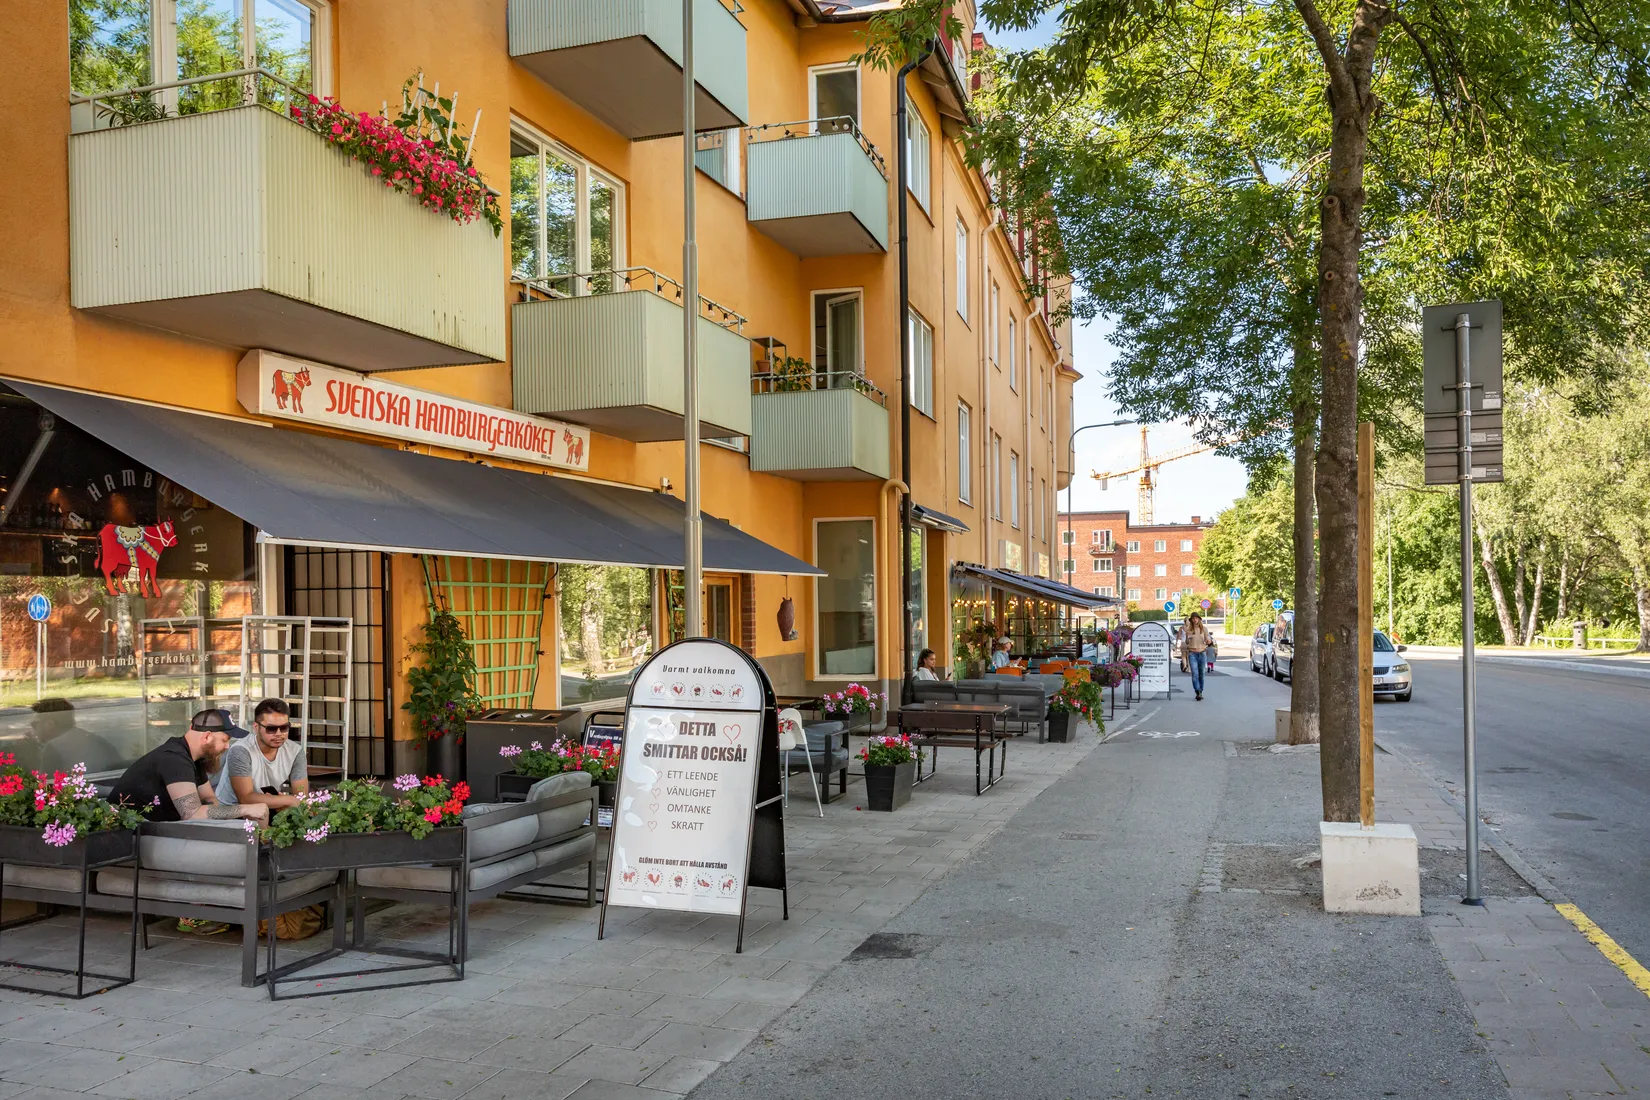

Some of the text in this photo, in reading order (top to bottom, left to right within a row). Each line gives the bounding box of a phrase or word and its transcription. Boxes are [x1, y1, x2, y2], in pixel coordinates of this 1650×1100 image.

[325, 379, 556, 455] SVENSKA HAMBURGERKÖKET
[61, 511, 114, 634] SVENSKA
[662, 664, 690, 674] Varmt
[679, 721, 717, 737] DETTA
[643, 743, 748, 762] SMITTAR OCKSÅ!
[667, 770, 719, 781] ETT LEENDE
[666, 785, 717, 798] VÄNLIGHET
[667, 803, 712, 815] OMTANKE
[671, 820, 705, 831] SKRATT
[638, 856, 654, 864] GLÖM
[689, 860, 706, 868] HÅLLA
[704, 861, 728, 870] AVSTÅND
